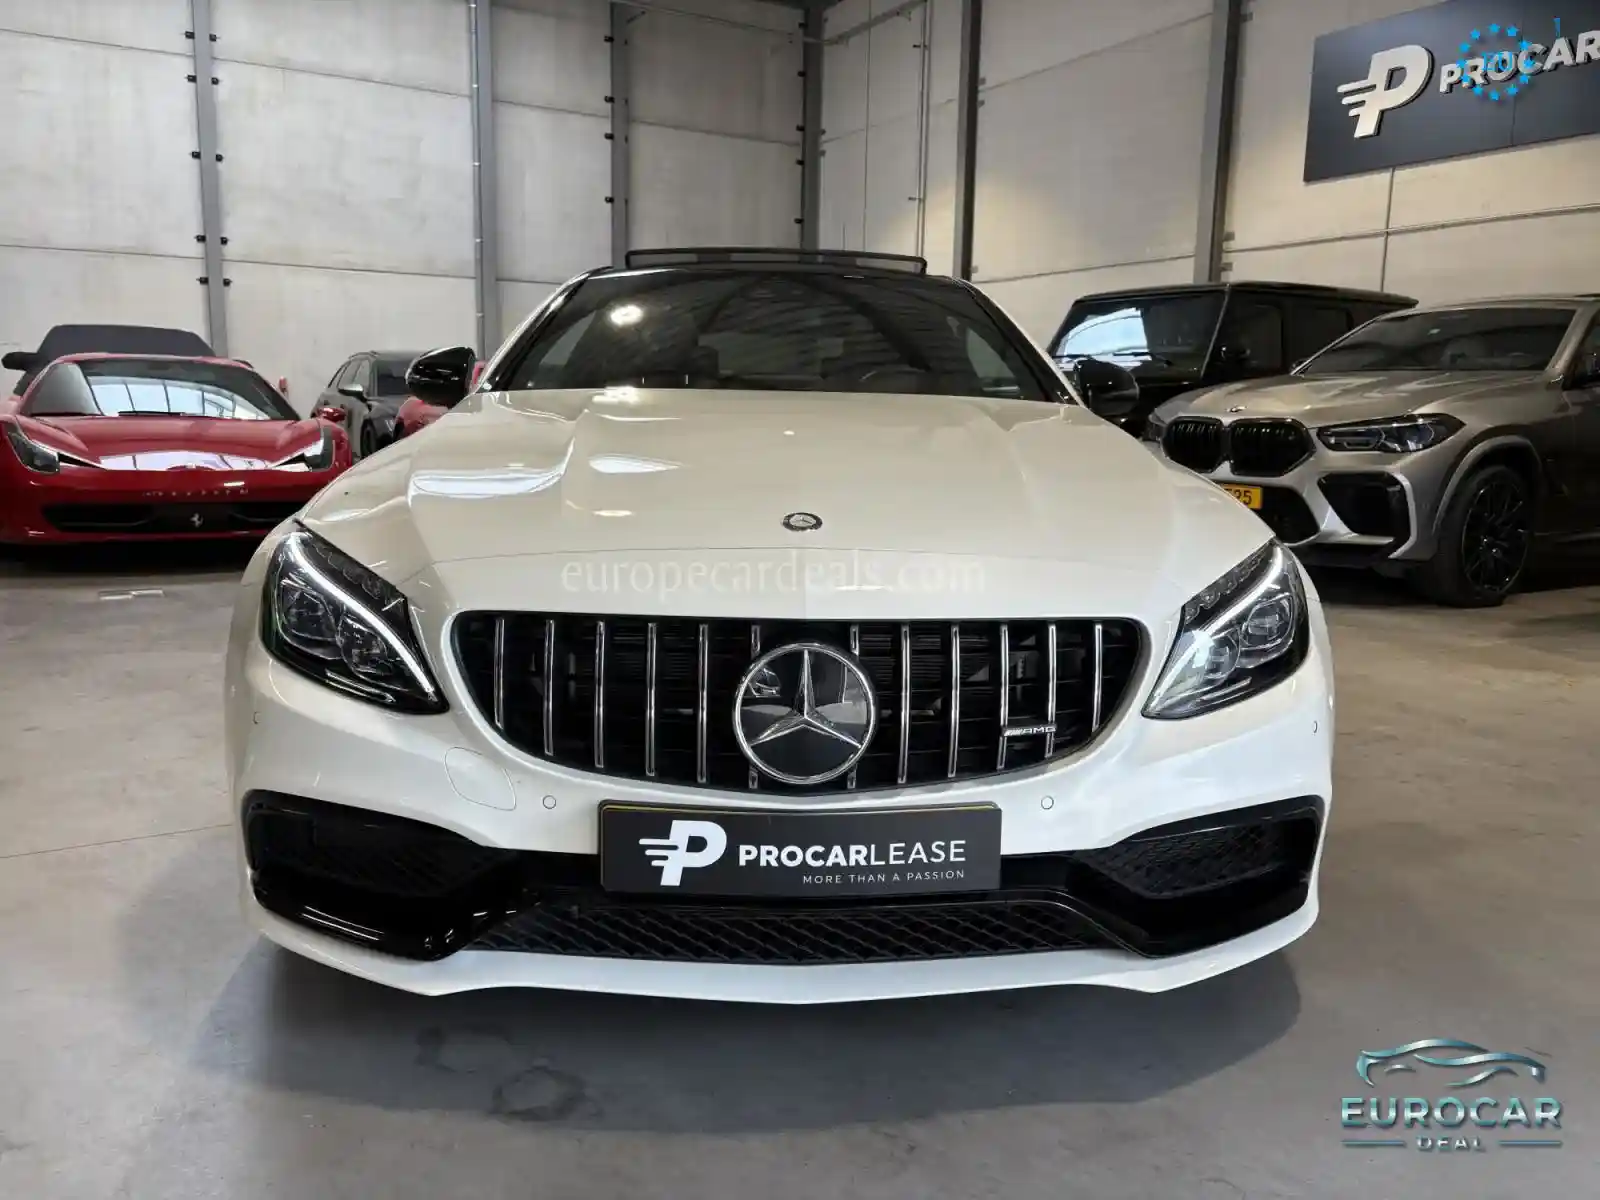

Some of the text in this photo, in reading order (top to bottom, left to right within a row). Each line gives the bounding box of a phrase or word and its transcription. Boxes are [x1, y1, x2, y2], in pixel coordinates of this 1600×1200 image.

[1439, 30, 1600, 93] PROCAR
[738, 839, 967, 868] PROCARLEASE
[802, 869, 965, 885] MORE THAN A PASSION
